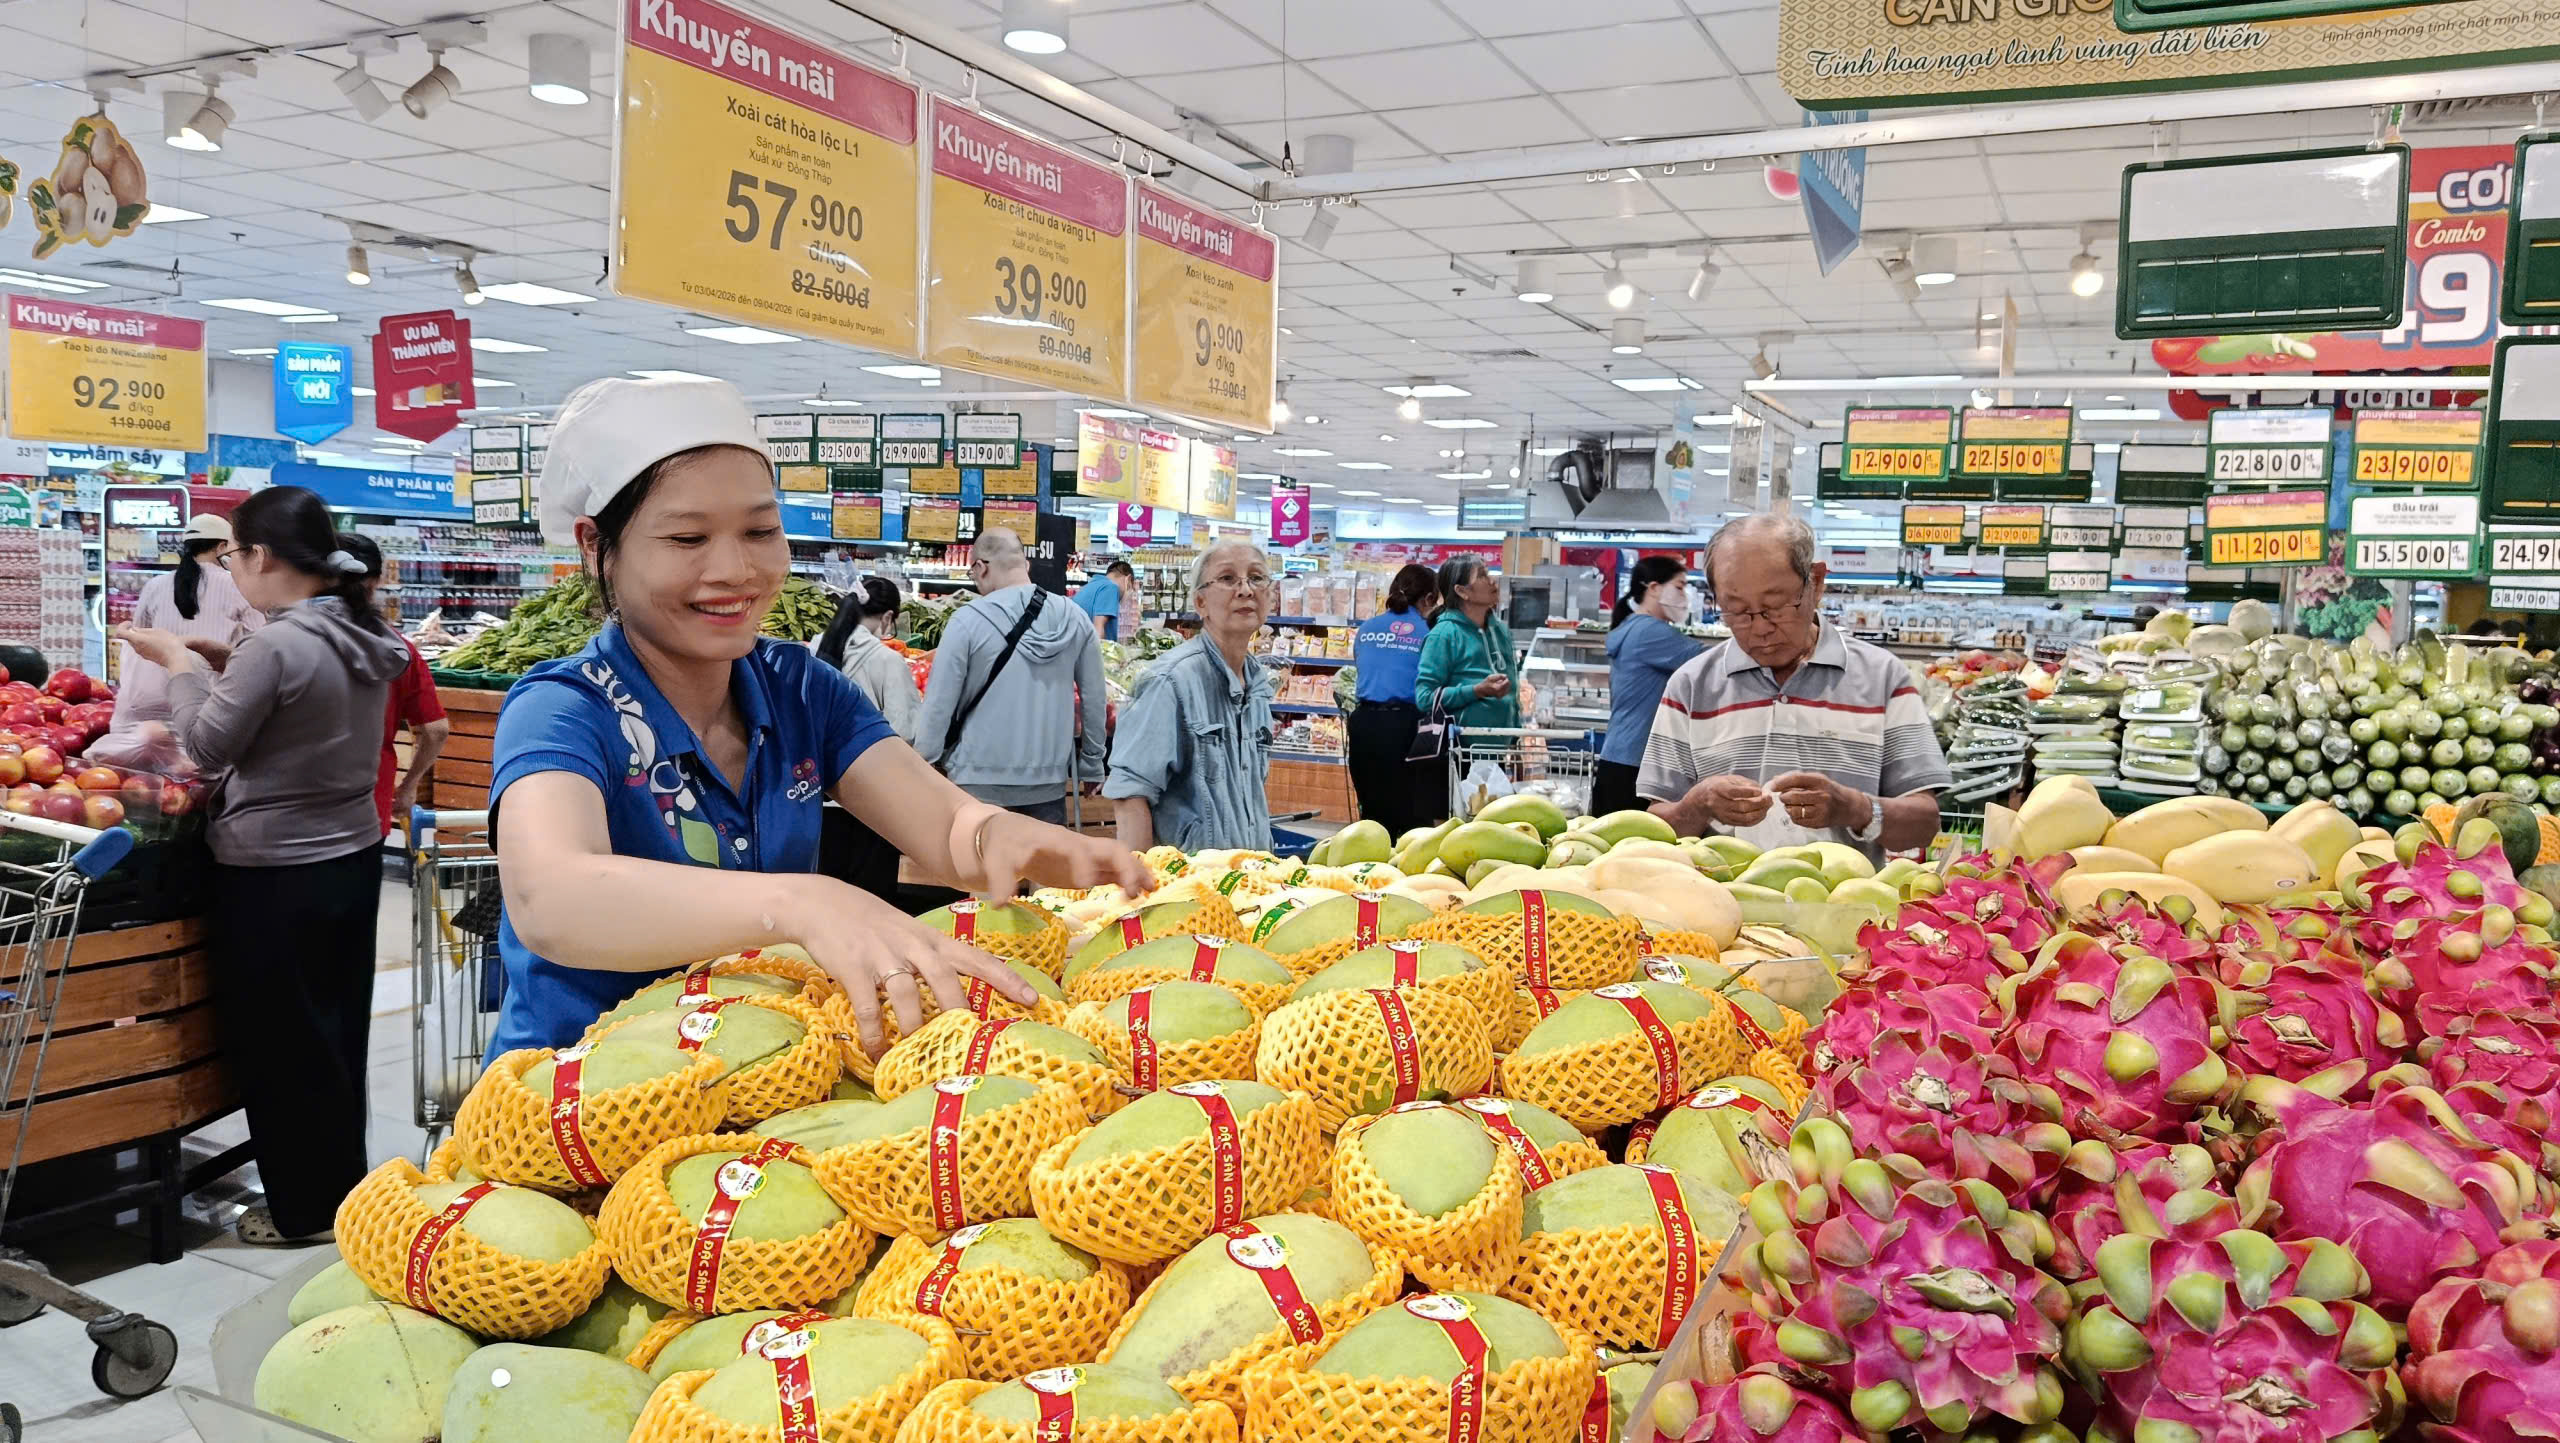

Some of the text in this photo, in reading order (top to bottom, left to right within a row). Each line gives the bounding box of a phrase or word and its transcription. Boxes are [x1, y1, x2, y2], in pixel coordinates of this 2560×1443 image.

[2385, 26, 2425, 39] mang
[2427, 18, 2456, 33] tính
[2494, 11, 2531, 26] minh
[1807, 47, 1876, 77] Tinh
[1883, 46, 1935, 71] hoa
[1937, 49, 1998, 77] ngọt
[2004, 35, 2067, 64] lành
[2075, 38, 2144, 67] vùng
[779, 61, 835, 101] mãi
[727, 96, 859, 158] Xoài cát hòa lộc L1
[801, 152, 811, 163] an
[812, 153, 831, 169] toàn
[938, 119, 1062, 194] Khuyến mãi
[983, 191, 1096, 243] Xoài cát chu da vàng L1
[1140, 196, 1233, 256] Khuyến mãi
[2415, 218, 2487, 249] Combo
[694, 284, 736, 303] 03/04/2026
[791, 268, 870, 310] 82.500đ
[16, 303, 145, 337] Khuyến mãi
[1855, 451, 1922, 470] 12.900
[1968, 449, 2042, 468] 22.500
[2220, 454, 2301, 472] 22.800
[2363, 455, 2449, 474] 23.900
[2218, 534, 2298, 556] 11.200
[2363, 544, 2445, 563] 15.500
[1530, 936, 1540, 959] CAO
[1394, 1025, 1409, 1051] CAO
[1401, 1053, 1414, 1085] LÃNH
[1648, 1024, 1667, 1046] ĐẶC
[1664, 1071, 1674, 1093] CAO
[569, 1147, 584, 1168] CAO
[940, 1189, 953, 1213] CAO
[1222, 1187, 1235, 1214] CAO
[1664, 1198, 1680, 1220] ĐẶC
[697, 1240, 715, 1268] ĐẶC
[1675, 1252, 1688, 1283] CAO
[413, 1256, 421, 1283] CAO
[1671, 1287, 1688, 1321] LÃNH
